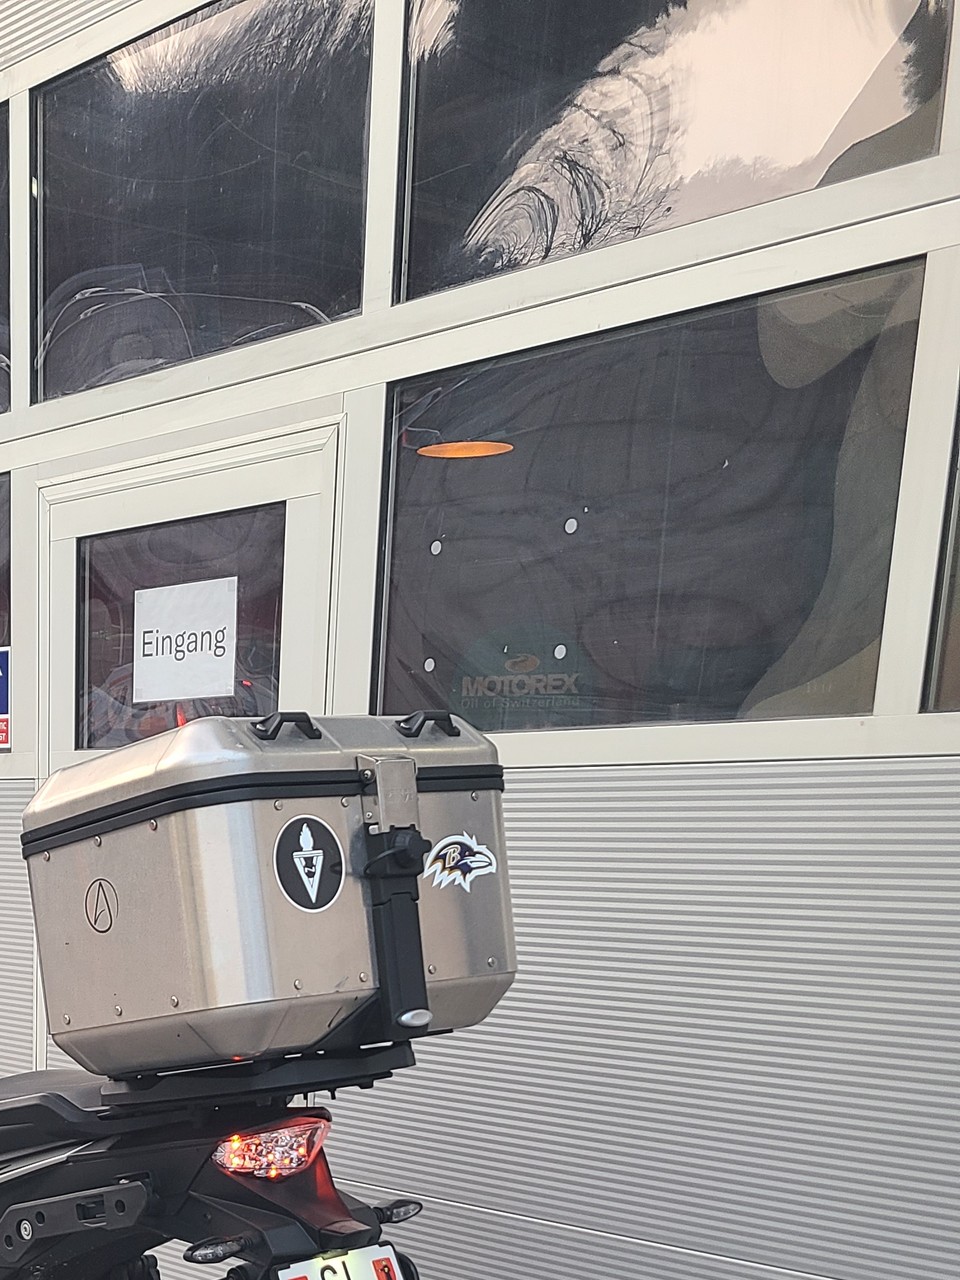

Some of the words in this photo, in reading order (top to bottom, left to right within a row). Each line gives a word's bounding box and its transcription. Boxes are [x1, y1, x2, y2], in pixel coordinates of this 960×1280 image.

[142, 626, 227, 661] Eingang
[461, 673, 580, 697] MOTOREX
[461, 698, 478, 709] Oil
[483, 697, 496, 709] of
[501, 696, 579, 708] Switzerland
